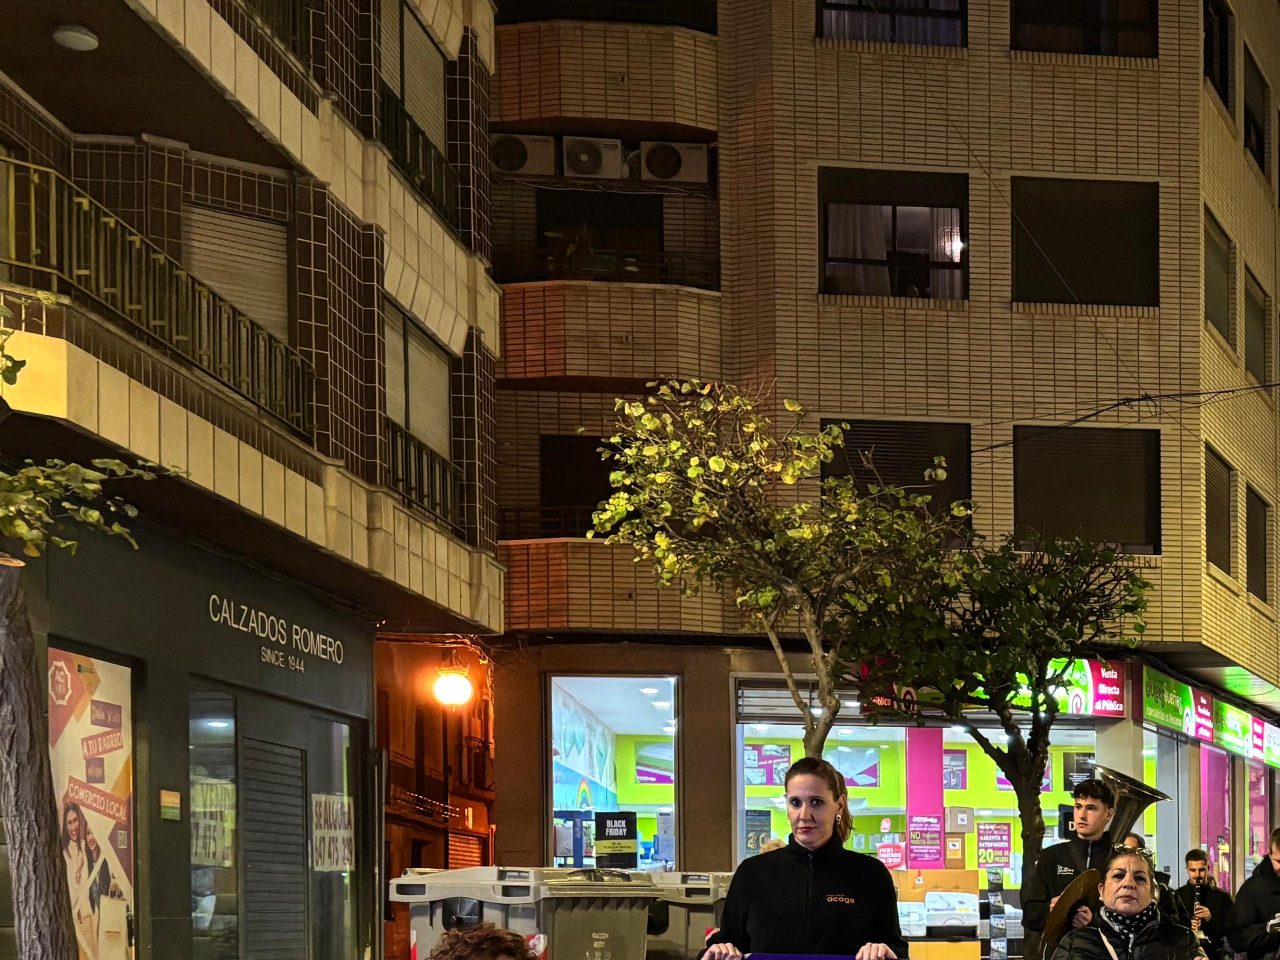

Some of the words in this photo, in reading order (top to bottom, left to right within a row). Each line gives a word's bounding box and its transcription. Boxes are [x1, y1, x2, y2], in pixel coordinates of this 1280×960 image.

[209, 594, 287, 645] CALZADOS
[292, 624, 344, 664] ROMERO
[261, 646, 285, 668] SINCE
[288, 655, 305, 674] 1944
[1101, 667, 1118, 679] Venta
[1098, 683, 1120, 695] Directa
[68, 782, 105, 811] COMERCIO
[105, 797, 127, 821] LOCAL
[606, 819, 626, 828] BLACK
[605, 828, 627, 837] FRIDAY
[979, 849, 994, 863] 20
